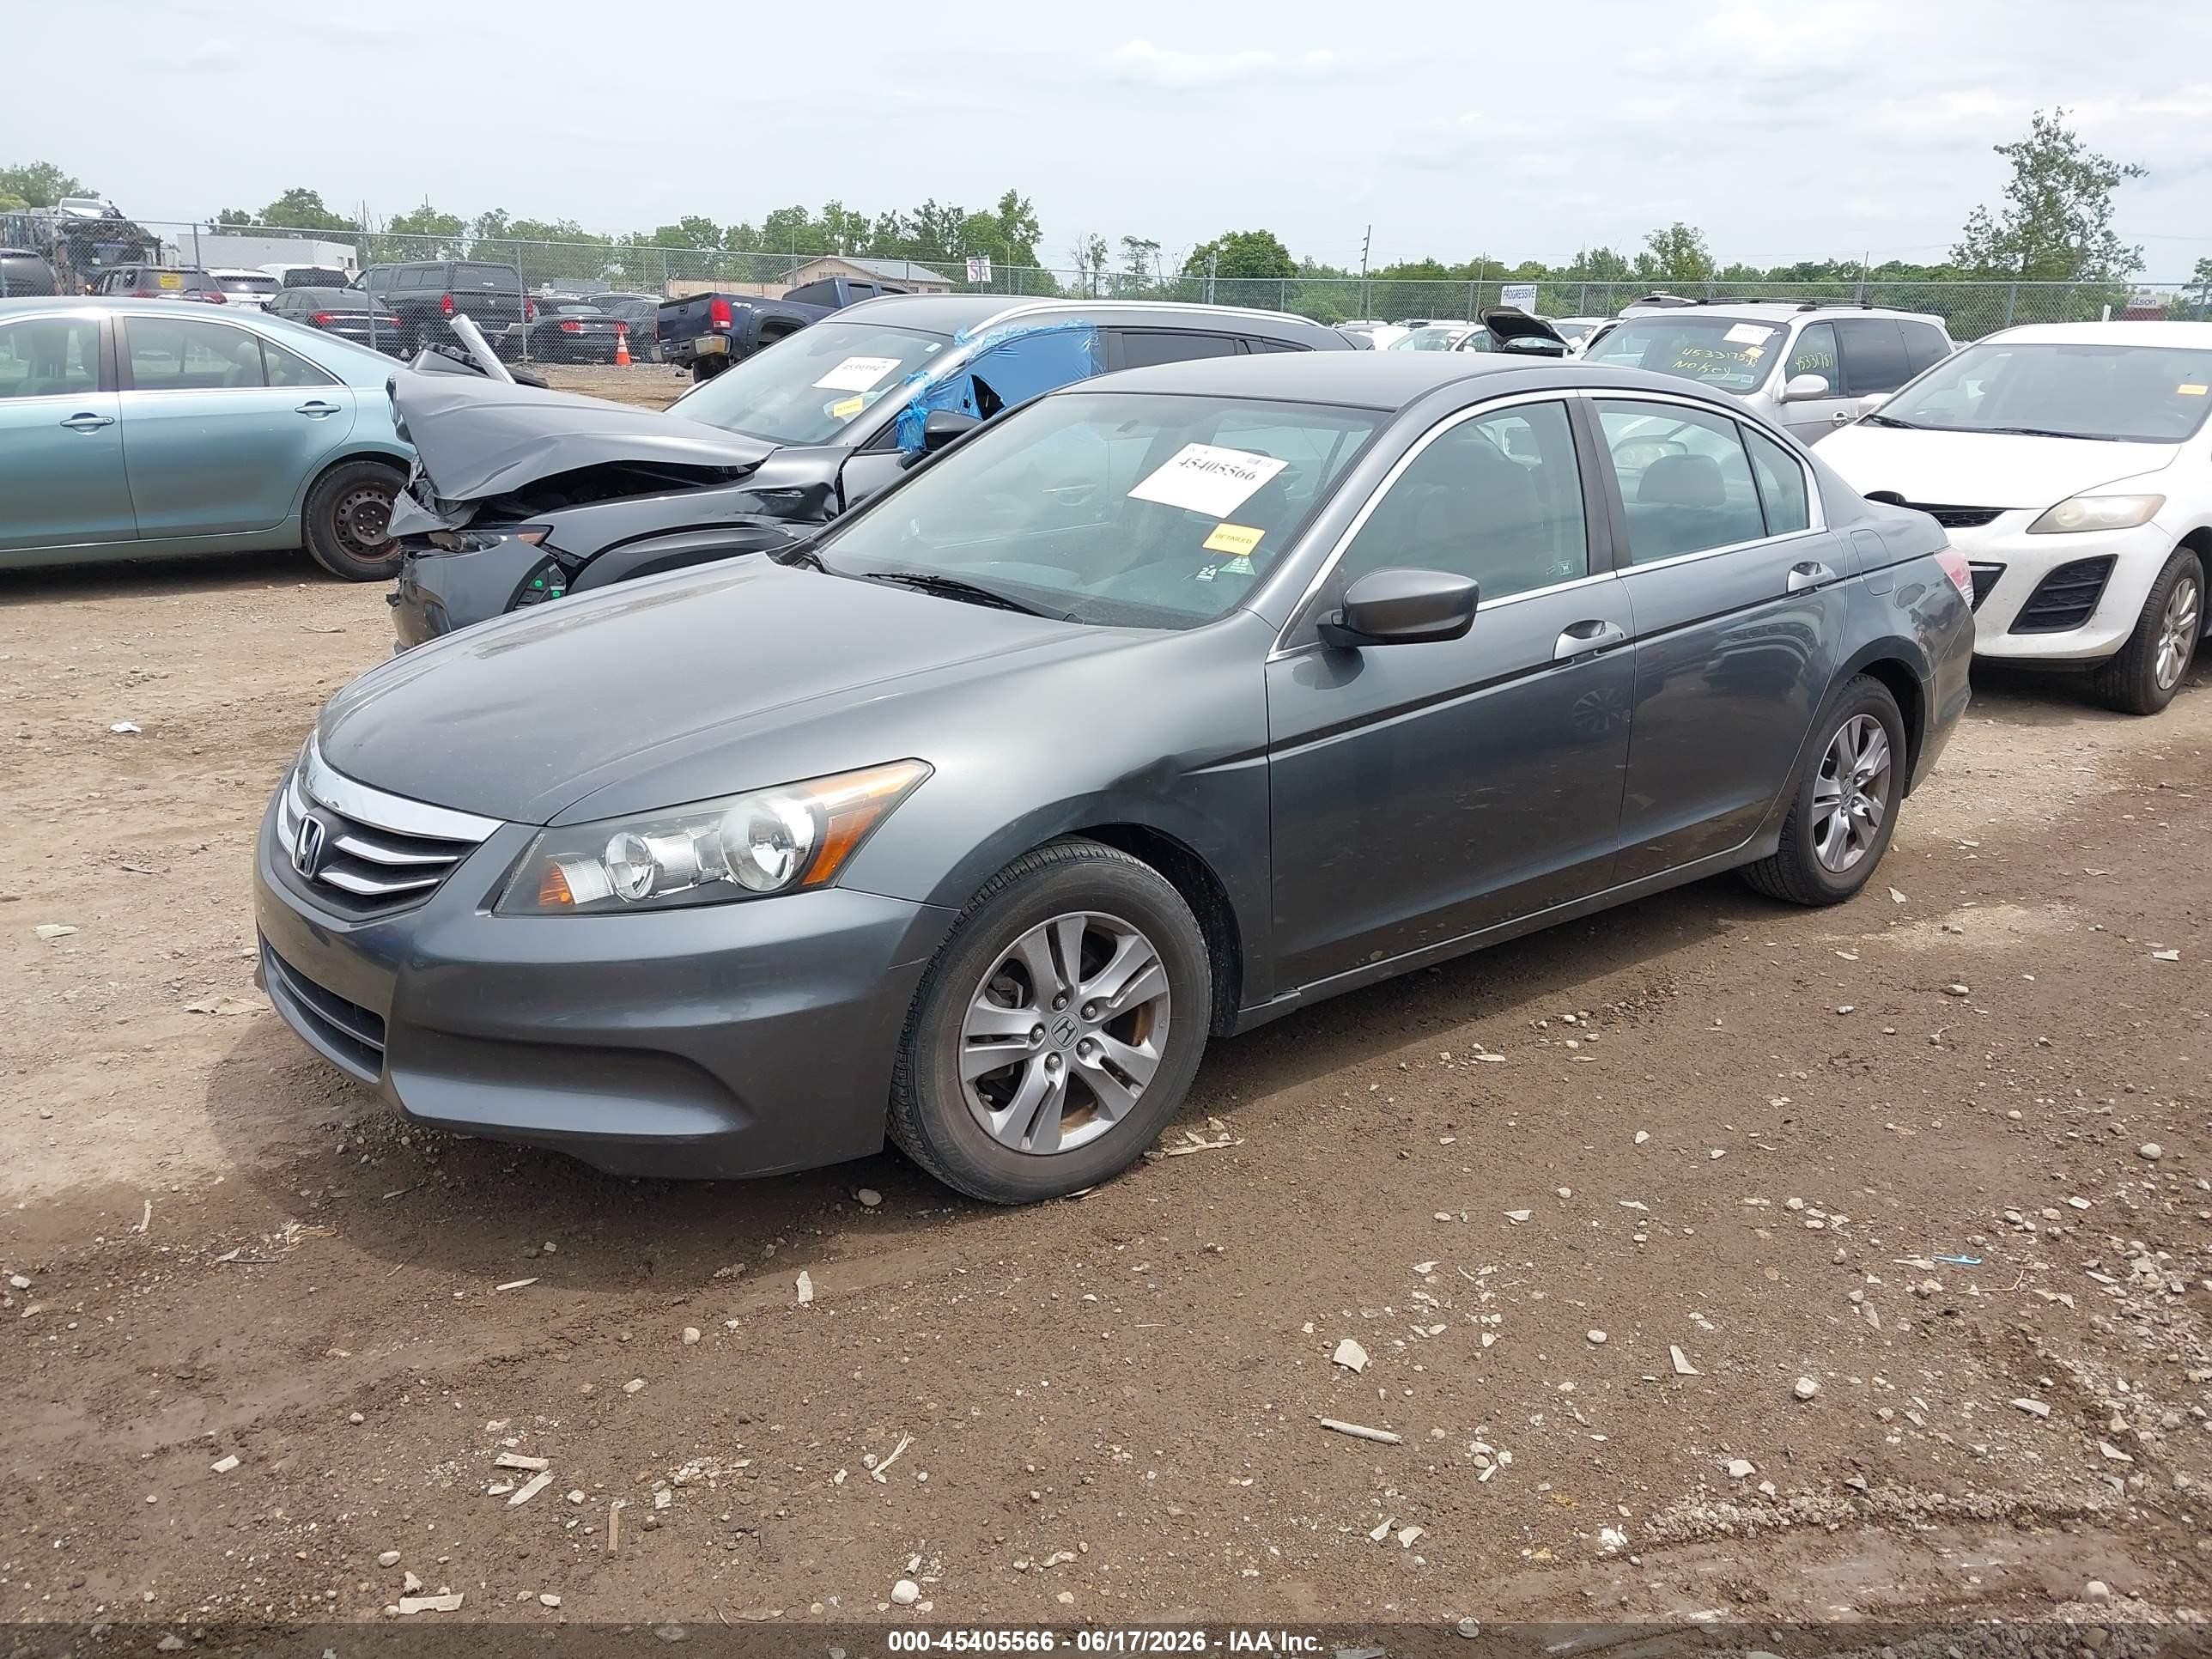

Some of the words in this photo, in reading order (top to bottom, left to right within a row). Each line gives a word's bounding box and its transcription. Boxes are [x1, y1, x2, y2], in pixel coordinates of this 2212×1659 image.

[1503, 288, 1535, 300] PROGRESSIVE
[1178, 458, 1257, 481] 45405566
[1214, 533, 1253, 544] DETAILED
[1232, 558, 1249, 567] 25
[1199, 567, 1217, 577] 24
